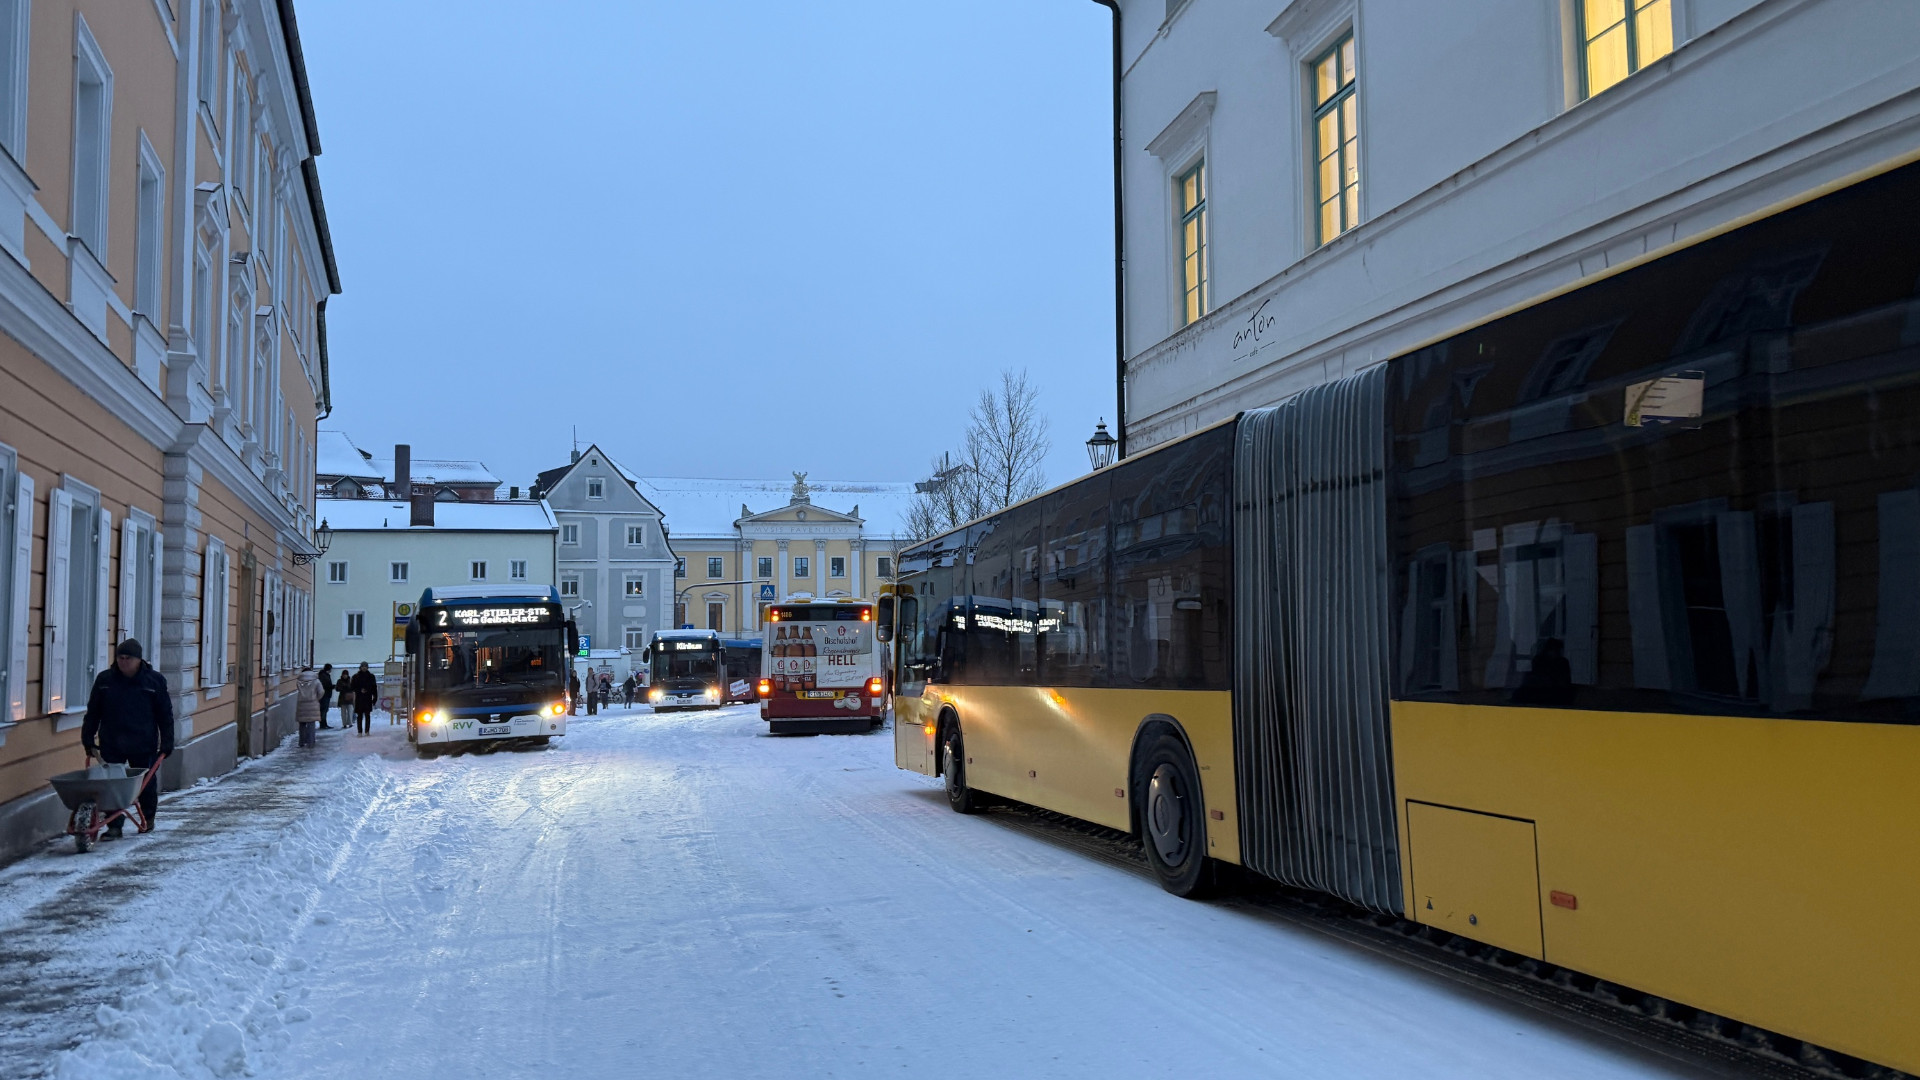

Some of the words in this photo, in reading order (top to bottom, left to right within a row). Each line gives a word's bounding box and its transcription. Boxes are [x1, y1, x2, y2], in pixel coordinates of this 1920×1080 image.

[1233, 299, 1275, 349] anton
[438, 610, 448, 626] 2
[454, 607, 550, 618] KARL-STIELER-STR.
[463, 617, 480, 625] via
[825, 637, 858, 645] Bischofshof
[828, 655, 856, 666] HELL
[453, 721, 474, 730] RVV
